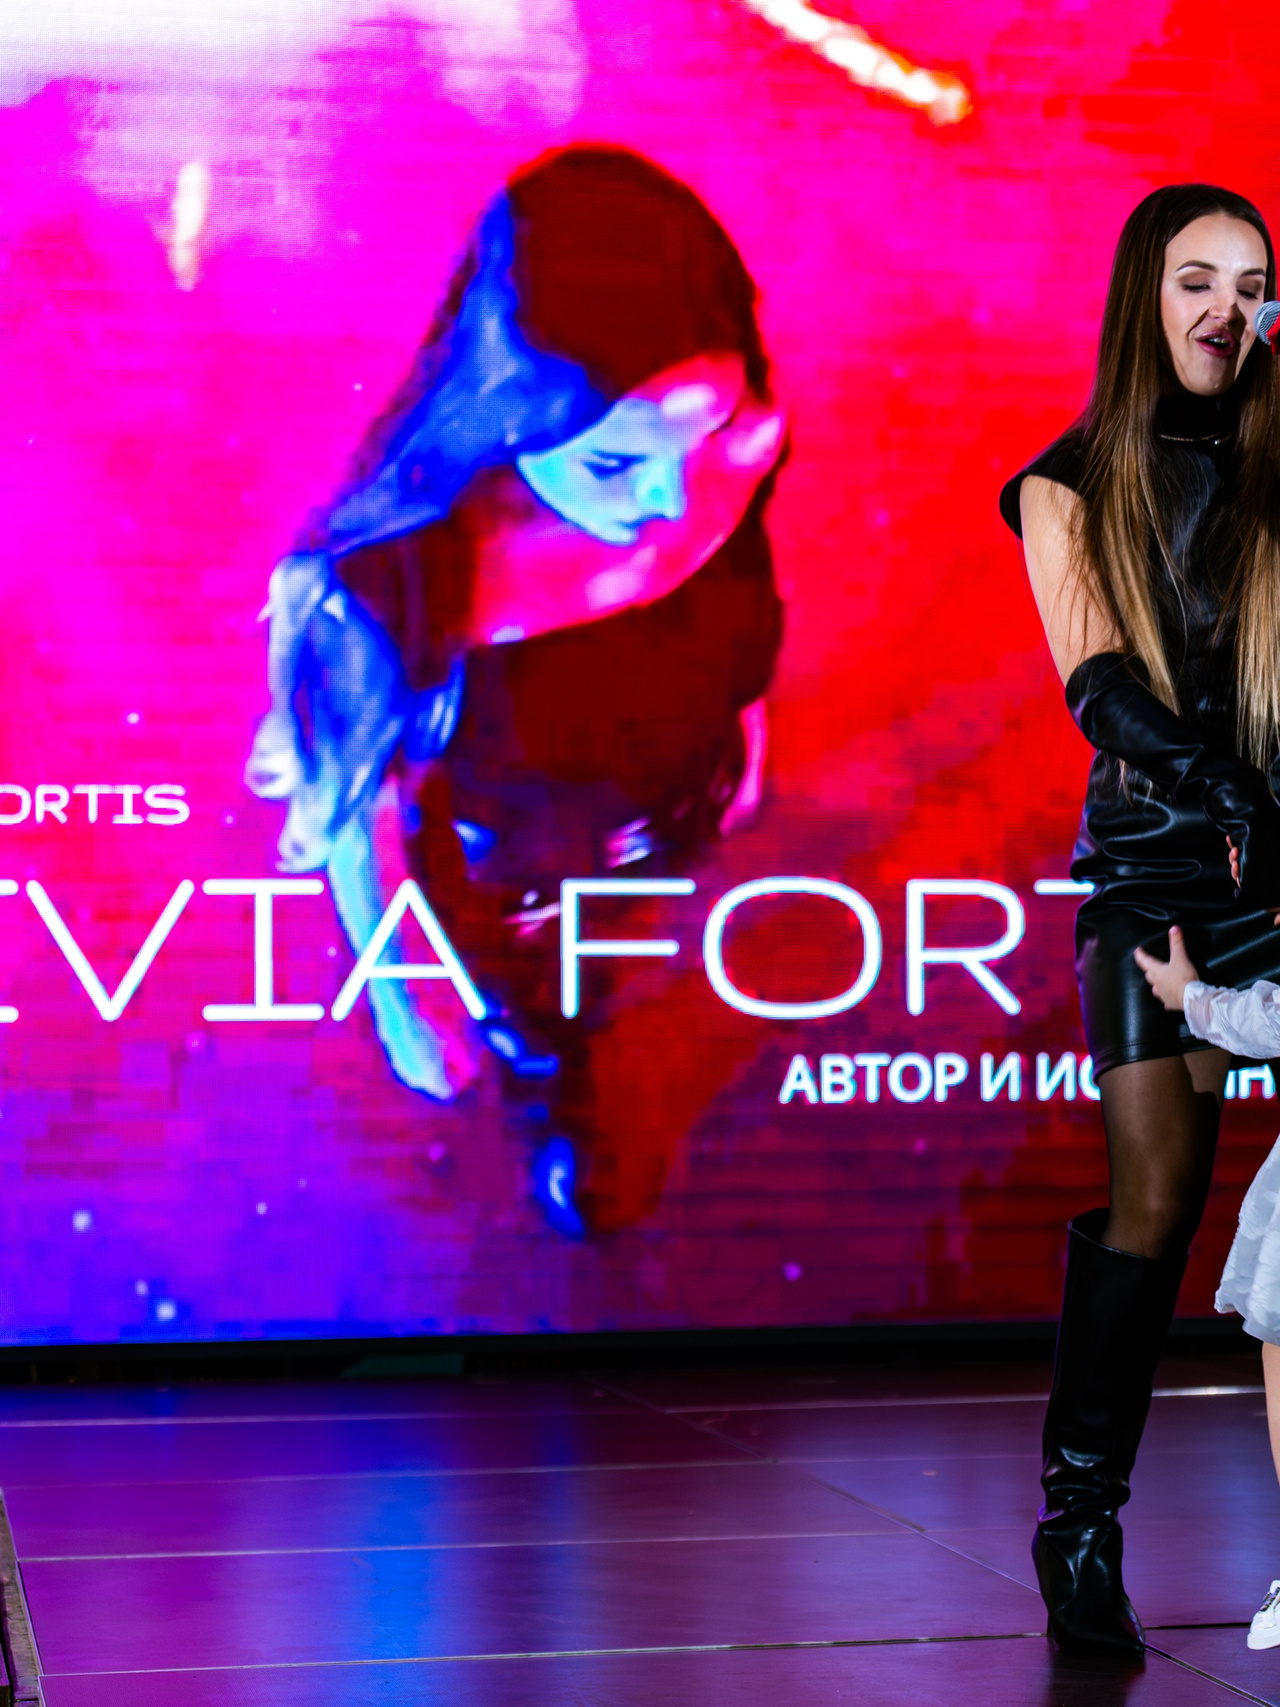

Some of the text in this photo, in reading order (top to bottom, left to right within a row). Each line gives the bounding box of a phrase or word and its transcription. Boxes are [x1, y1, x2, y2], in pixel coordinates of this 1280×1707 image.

[0, 878, 487, 1023] VIA
[778, 1052, 969, 1105] АВТОР
[980, 1052, 1022, 1102] И
